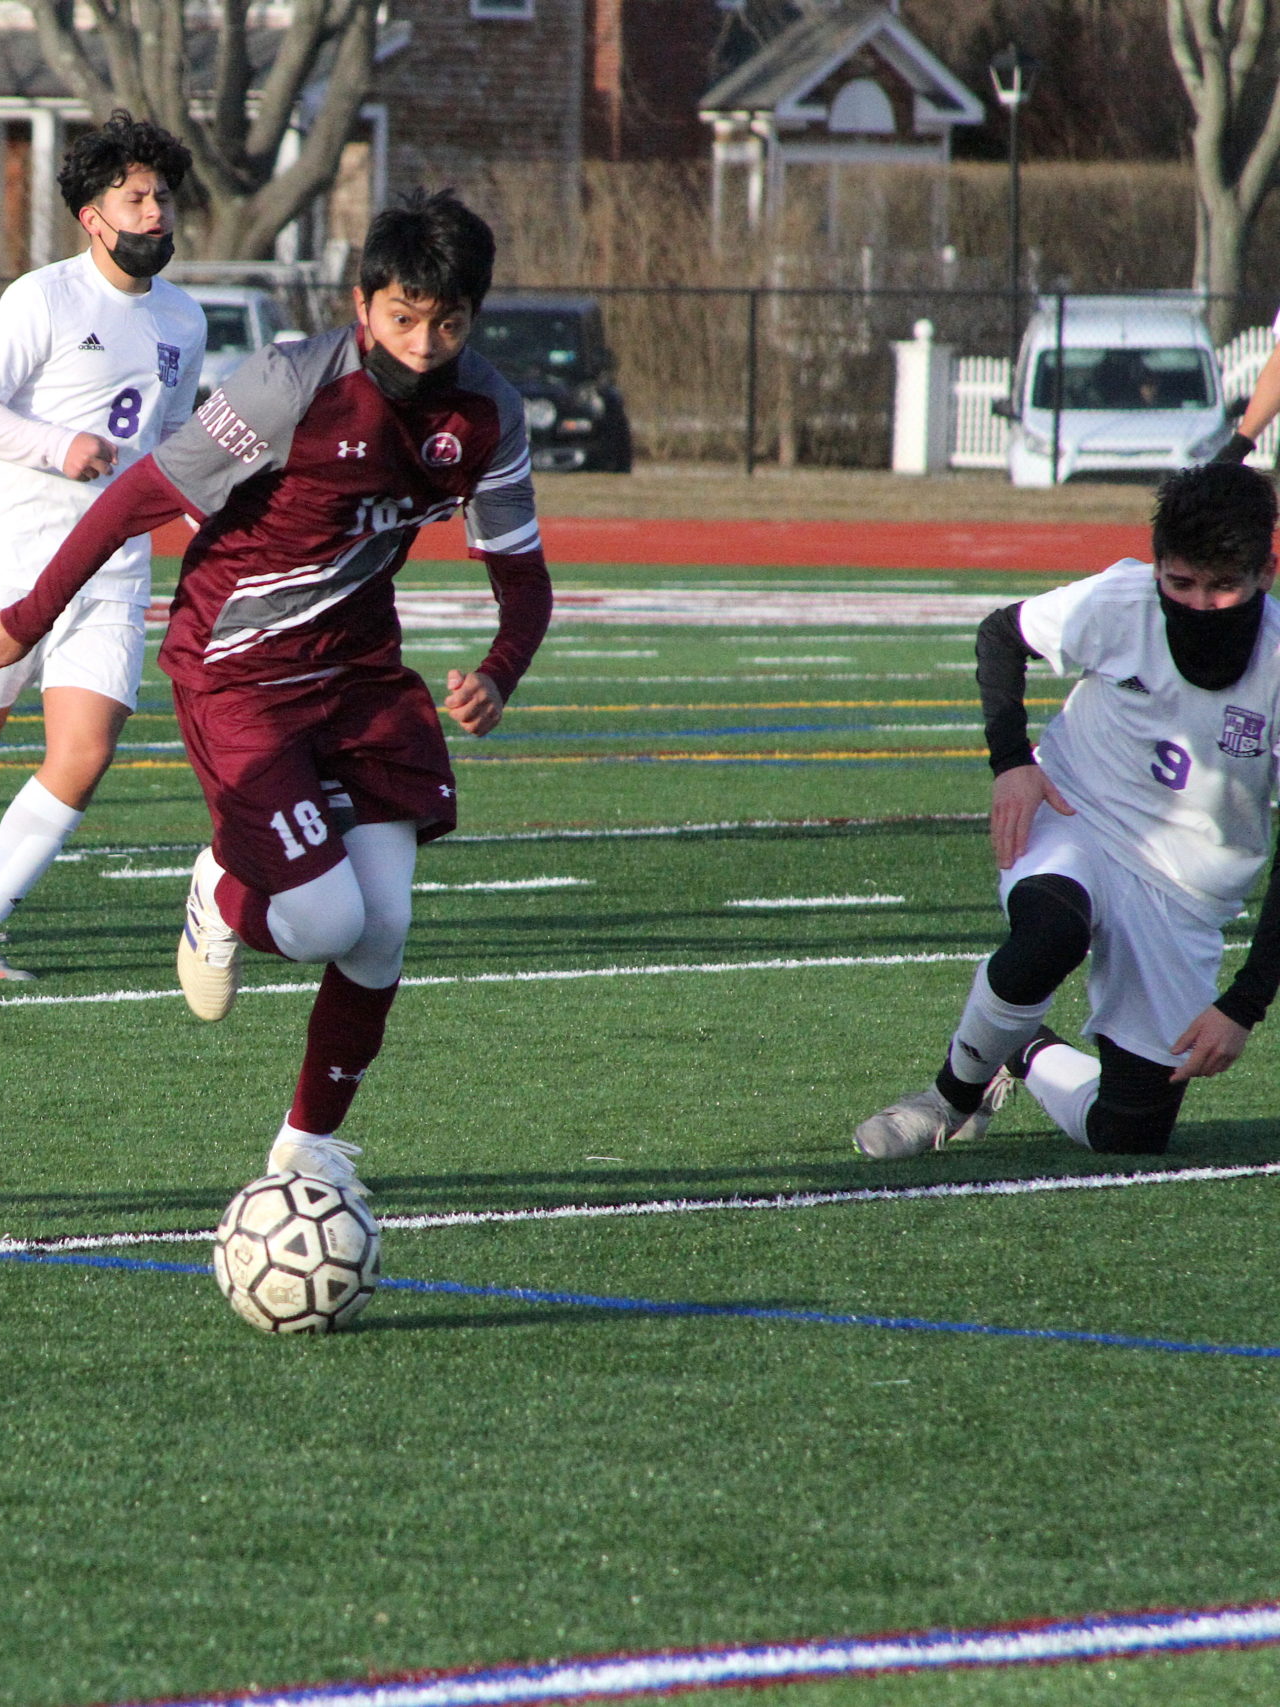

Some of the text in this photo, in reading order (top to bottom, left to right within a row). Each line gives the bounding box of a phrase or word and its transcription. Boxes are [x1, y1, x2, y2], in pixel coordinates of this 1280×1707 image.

[108, 387, 143, 439] 8
[198, 388, 269, 463] RINERS
[1150, 740, 1192, 791] 9
[270, 800, 328, 861] 18
